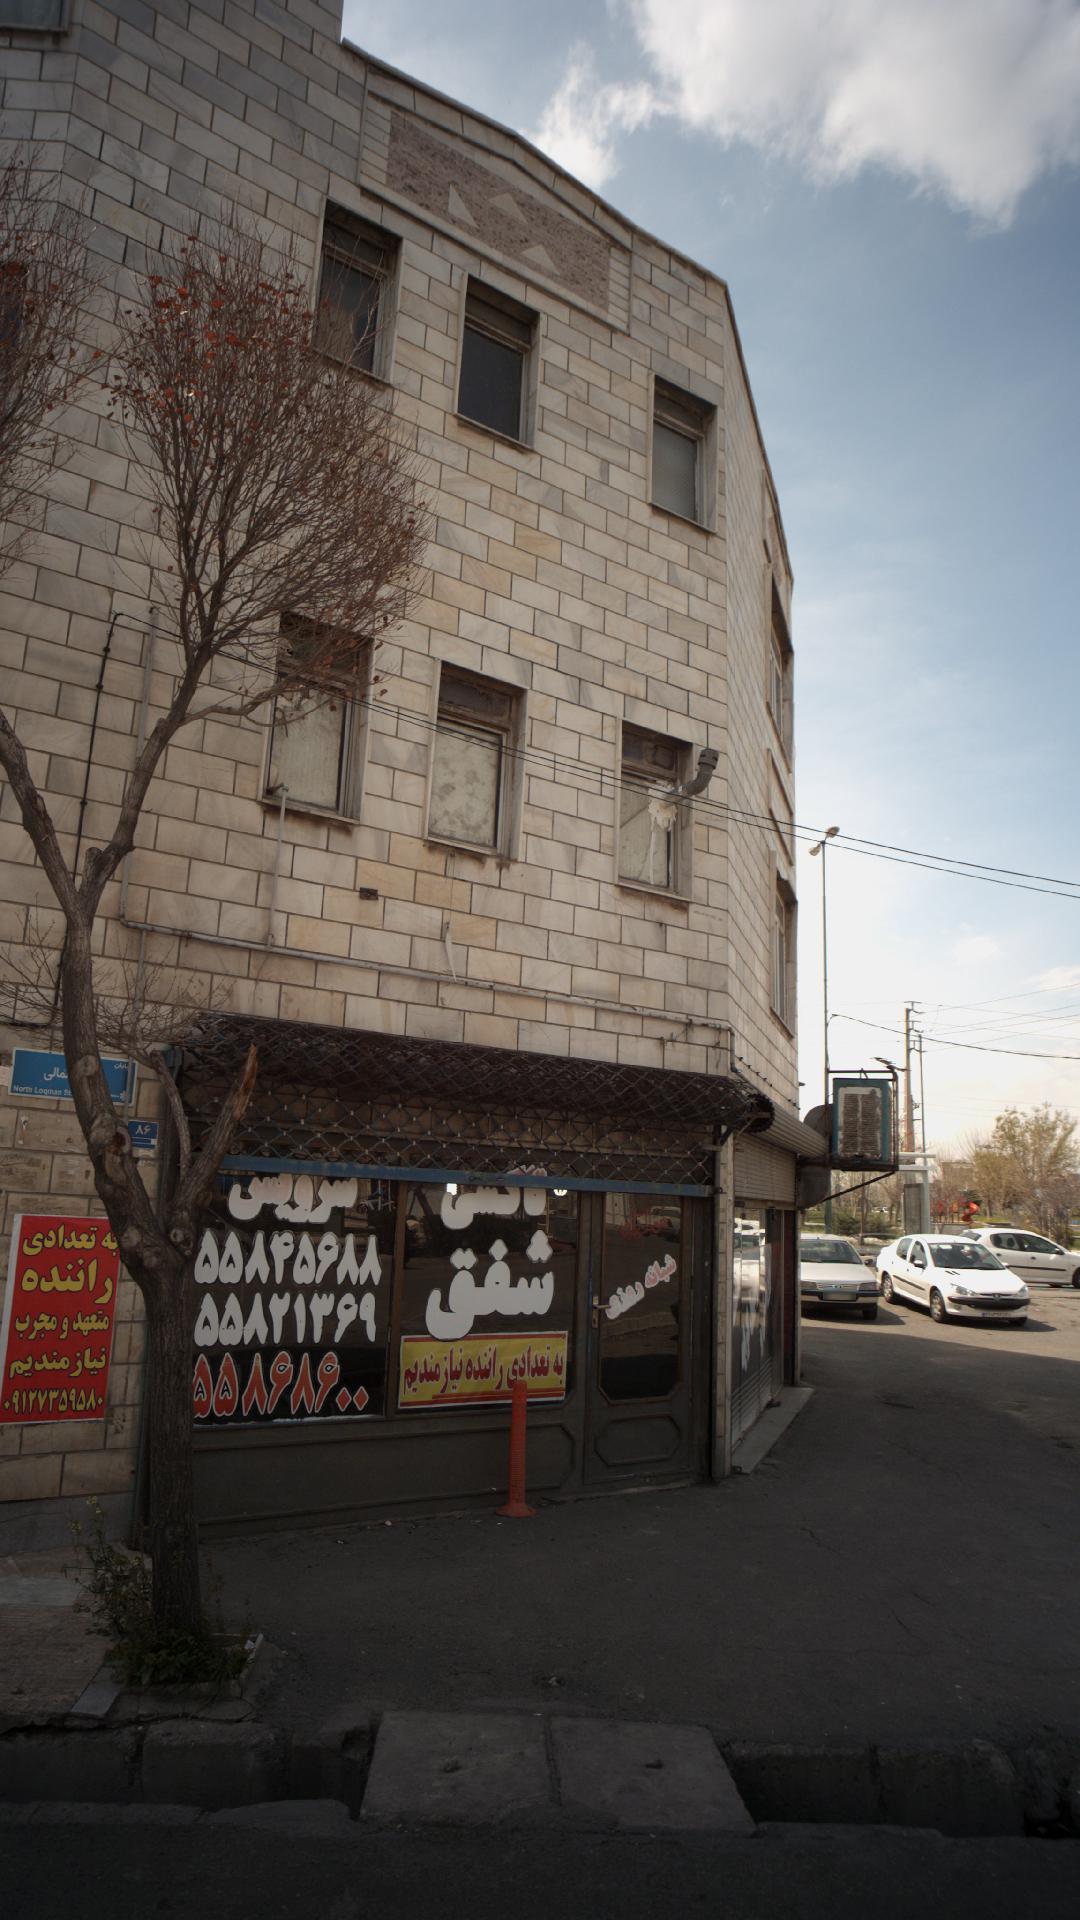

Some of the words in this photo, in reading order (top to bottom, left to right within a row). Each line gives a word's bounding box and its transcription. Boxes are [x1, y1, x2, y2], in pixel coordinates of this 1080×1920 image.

[13, 1084, 33, 1093] North
[43, 1066, 69, 1081] مالی
[135, 1124, 152, 1136] ۸۶
[228, 1173, 358, 1224] سرویس
[22, 1224, 98, 1256] تعدادی
[101, 1231, 120, 1258] به
[194, 1230, 382, 1286] ۵۵۸۴۵۶۸۸
[20, 1257, 114, 1305] راننده
[425, 1229, 556, 1341] شفق
[14, 1312, 58, 1340] مجرب
[59, 1316, 69, 1340] و
[72, 1310, 110, 1337] متعهد
[193, 1292, 377, 1348] ۵۵۸۲۱۳۶۹
[9, 1347, 107, 1380] نیازمندیم
[465, 1346, 504, 1390] راننده
[506, 1344, 552, 1389] تعدادی
[553, 1349, 565, 1385] به
[3, 1386, 104, 1416] ۰۹۱۲۷۳۵۹۵۸۰
[192, 1350, 370, 1419] ۵۵۸۶۸۶۰۰
